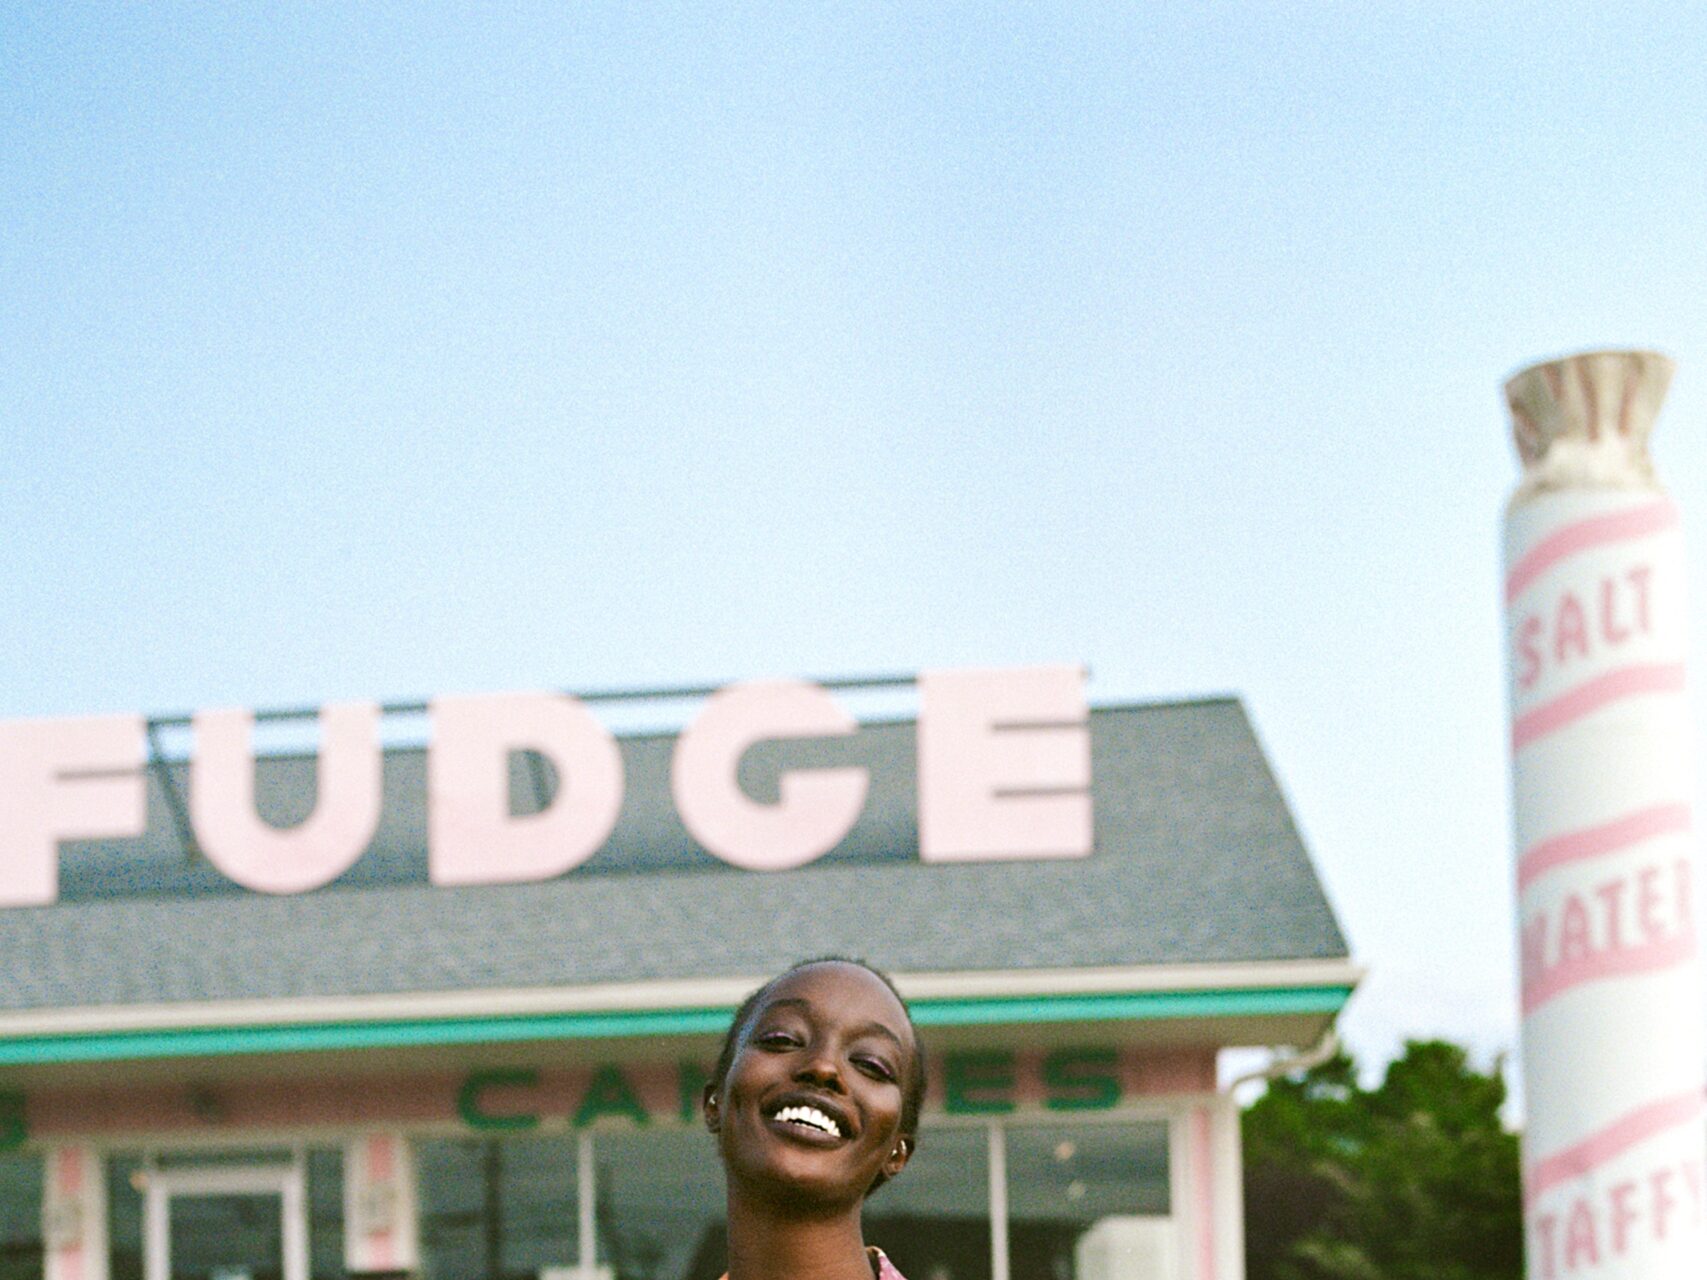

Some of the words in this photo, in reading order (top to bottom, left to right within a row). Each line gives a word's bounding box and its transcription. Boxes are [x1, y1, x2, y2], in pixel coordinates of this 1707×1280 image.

[1514, 566, 1652, 688] SALT
[0, 665, 1093, 907] FUDGE
[457, 1046, 1123, 1128] CAES
